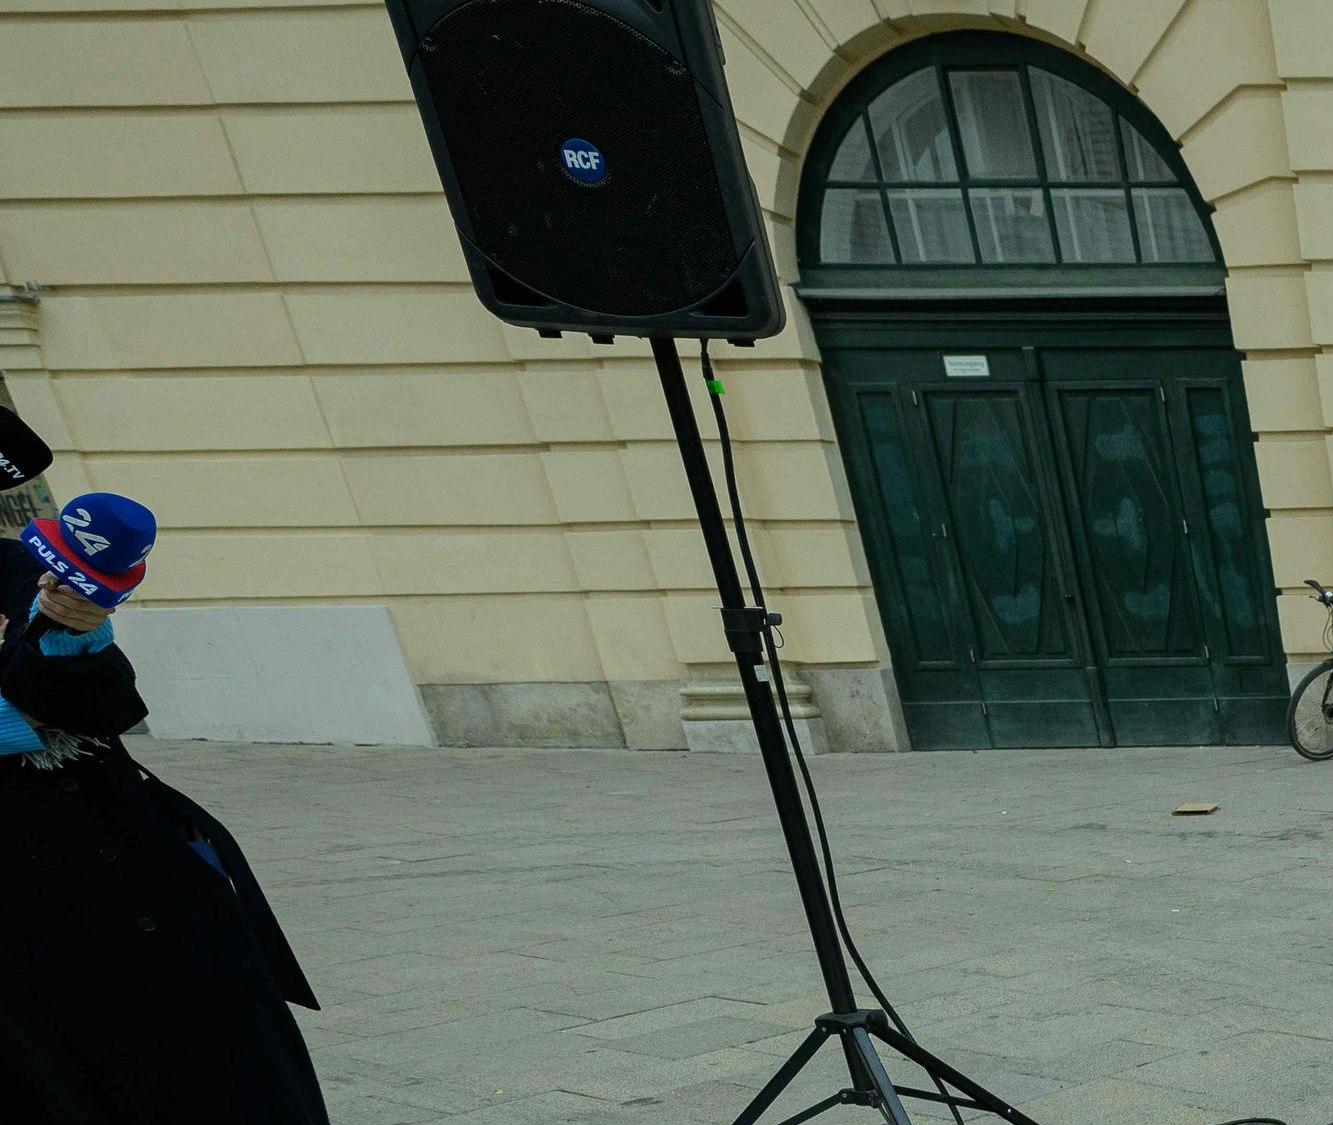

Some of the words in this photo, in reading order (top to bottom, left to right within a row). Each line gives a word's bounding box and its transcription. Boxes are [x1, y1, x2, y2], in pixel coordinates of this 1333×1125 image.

[563, 149, 600, 170] RCF
[62, 508, 111, 556] 24
[28, 534, 69, 574] PULS
[67, 572, 99, 596] 24
